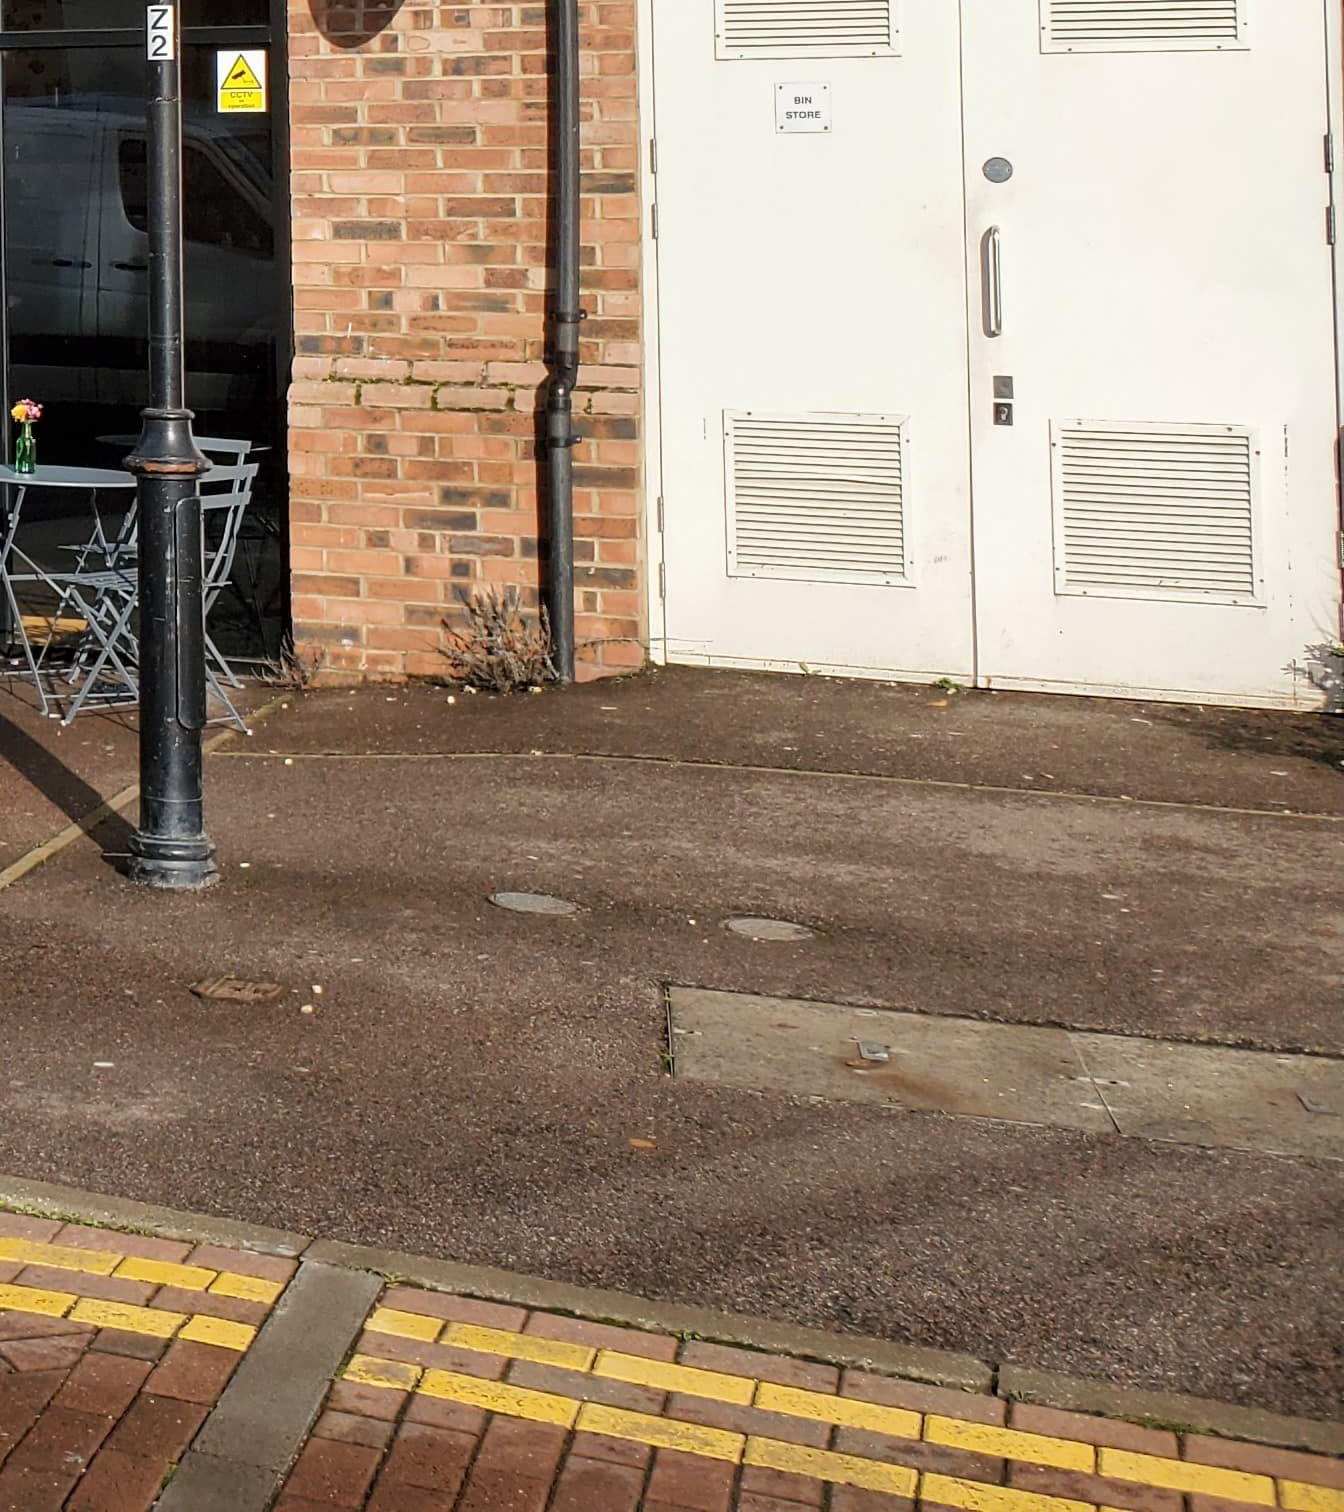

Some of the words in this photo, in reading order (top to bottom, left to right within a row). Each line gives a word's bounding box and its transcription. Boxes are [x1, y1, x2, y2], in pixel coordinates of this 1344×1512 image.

[150, 8, 169, 30] Z
[151, 35, 169, 57] 2
[230, 91, 254, 99] CCTV
[794, 96, 813, 105] BIN
[785, 111, 822, 119] STORE
